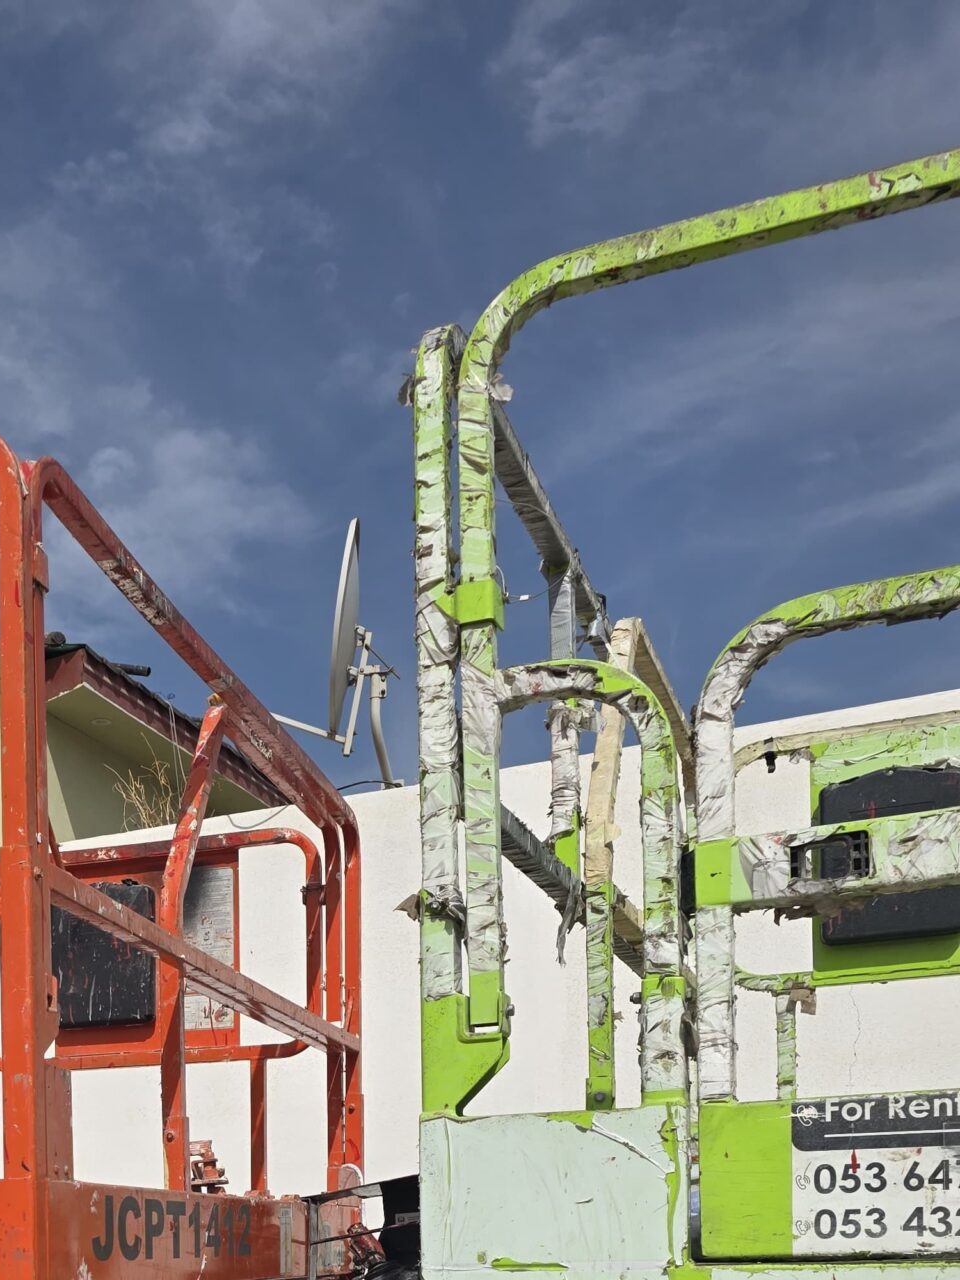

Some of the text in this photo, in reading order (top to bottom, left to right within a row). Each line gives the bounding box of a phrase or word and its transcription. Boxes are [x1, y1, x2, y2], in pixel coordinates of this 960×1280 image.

[825, 1099, 876, 1123] For
[813, 1159, 960, 1195] 053 64
[91, 1195, 252, 1262] JCPT1412
[813, 1206, 960, 1240] 053 43
